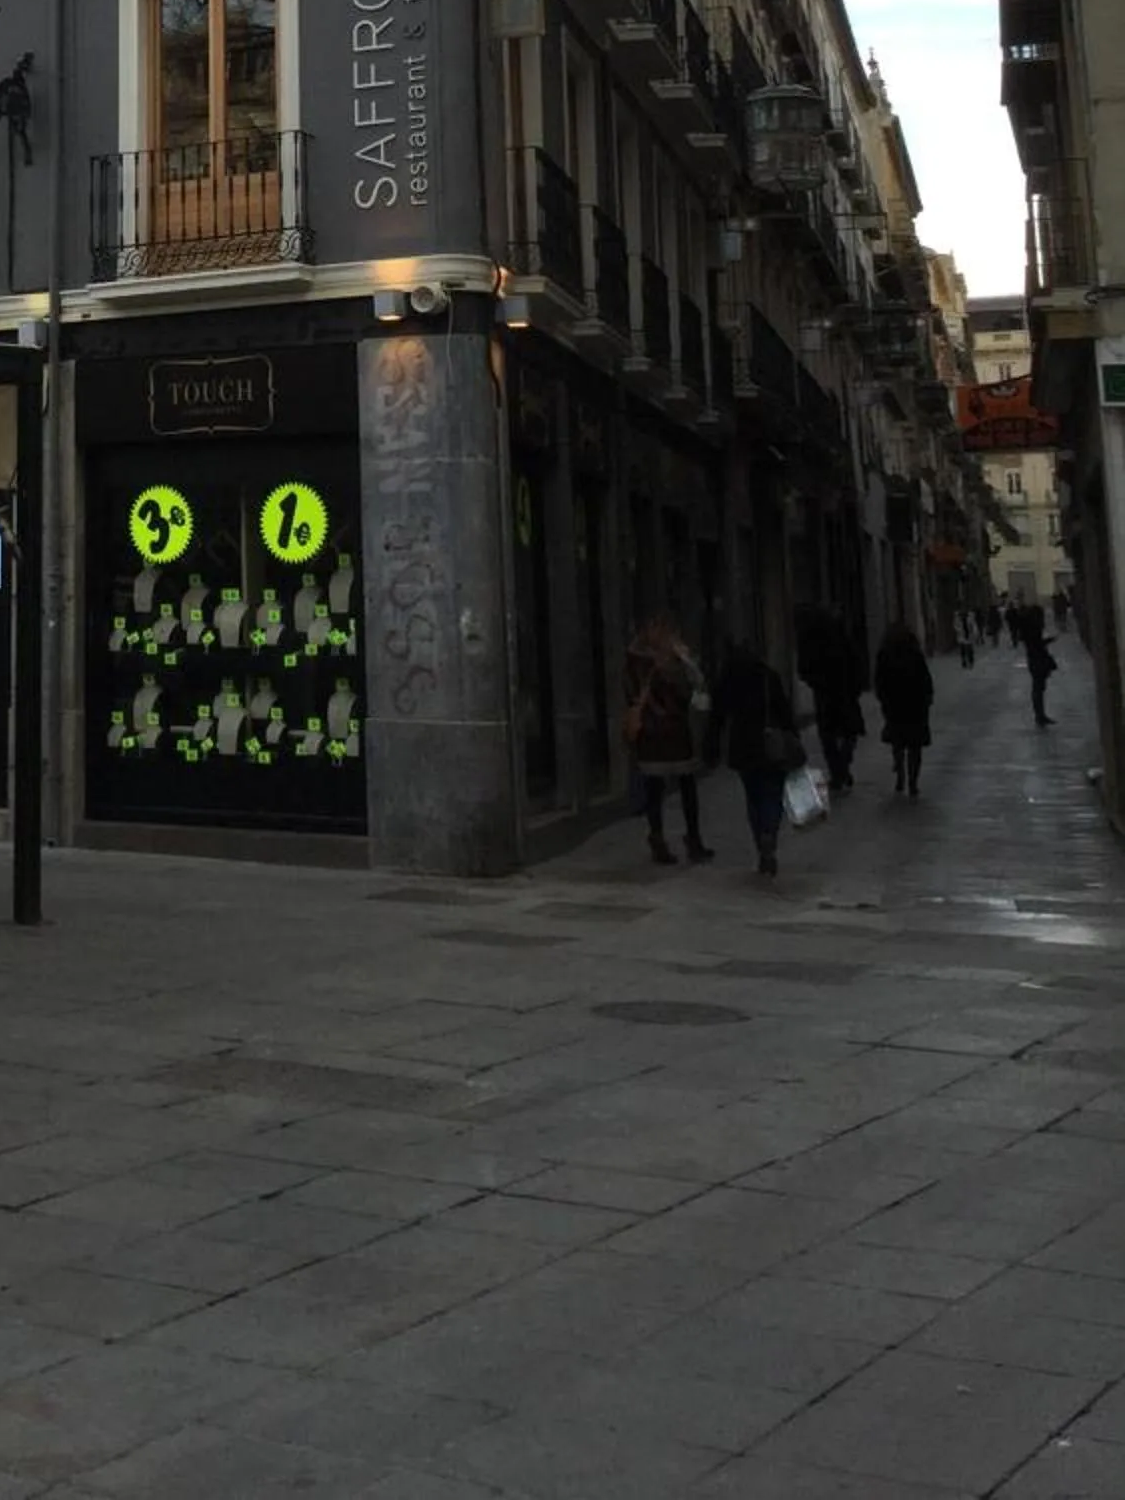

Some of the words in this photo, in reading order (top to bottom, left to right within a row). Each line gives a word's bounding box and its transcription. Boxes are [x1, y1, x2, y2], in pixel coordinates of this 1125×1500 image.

[403, 21, 426, 39] &
[403, 53, 428, 207] restaurant
[167, 378, 255, 406] TOUCH
